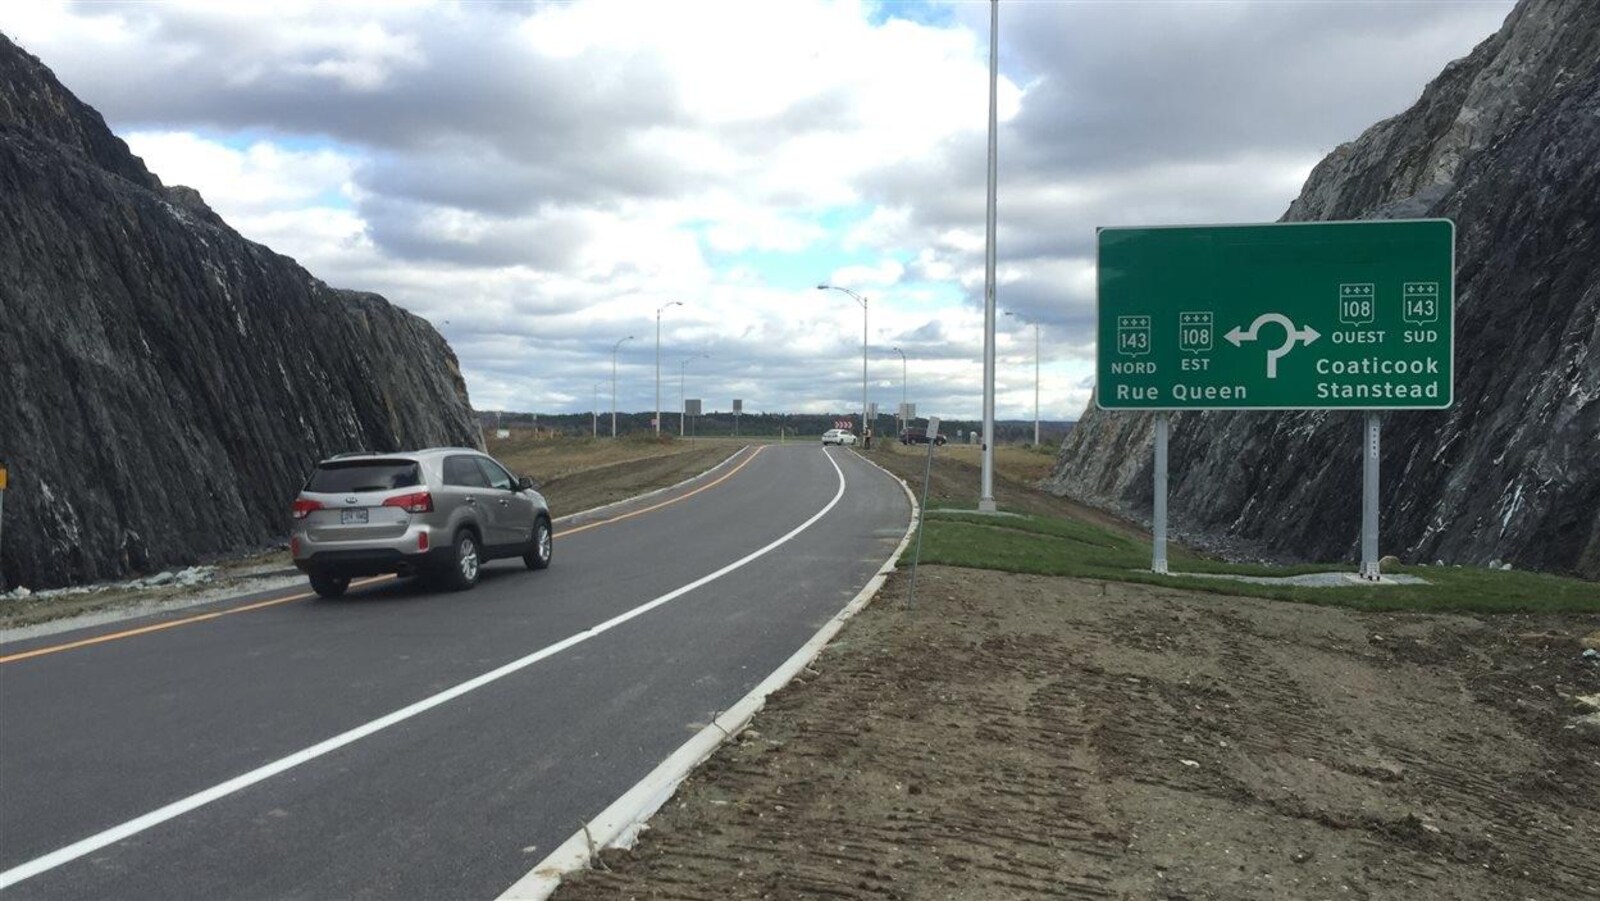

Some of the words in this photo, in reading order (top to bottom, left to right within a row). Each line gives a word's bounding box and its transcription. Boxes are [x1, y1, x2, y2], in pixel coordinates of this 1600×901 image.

[1343, 300, 1371, 318] 108
[1407, 299, 1435, 316] 143
[1120, 332, 1147, 349] 143
[1183, 328, 1209, 345] 108
[1331, 330, 1386, 344] OUEST
[1403, 330, 1438, 343] SUD
[1111, 361, 1157, 375] NORD
[1181, 358, 1211, 371] EST
[1316, 356, 1439, 375] Coaticook
[1116, 384, 1159, 400] Rue
[1172, 383, 1247, 401] Queen
[1316, 380, 1439, 399] Stanstead
